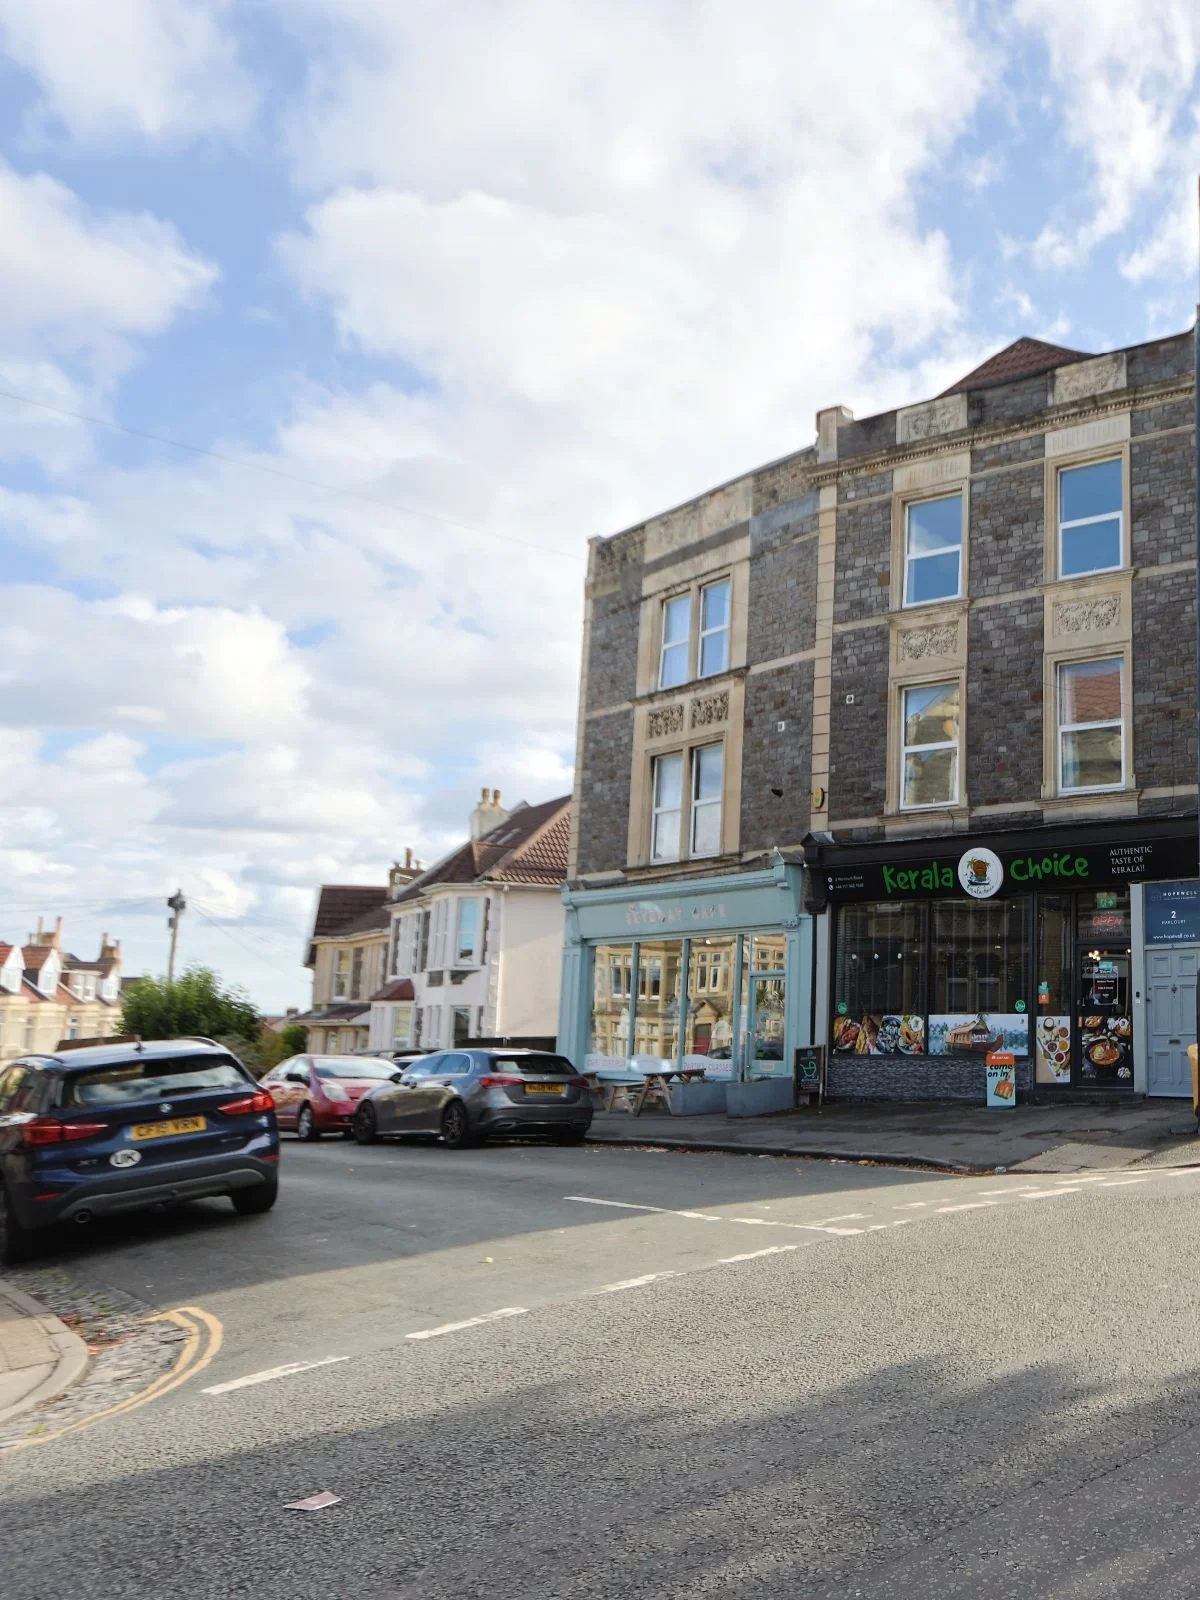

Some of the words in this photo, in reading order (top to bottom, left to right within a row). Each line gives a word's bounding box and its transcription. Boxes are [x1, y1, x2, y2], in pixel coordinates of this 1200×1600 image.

[1110, 846, 1152, 856] AUTHENTIC
[882, 862, 954, 893] Kerala
[1010, 853, 1088, 880] Choice
[1171, 910, 1176, 918] 2
[112, 1152, 138, 1165] UK
